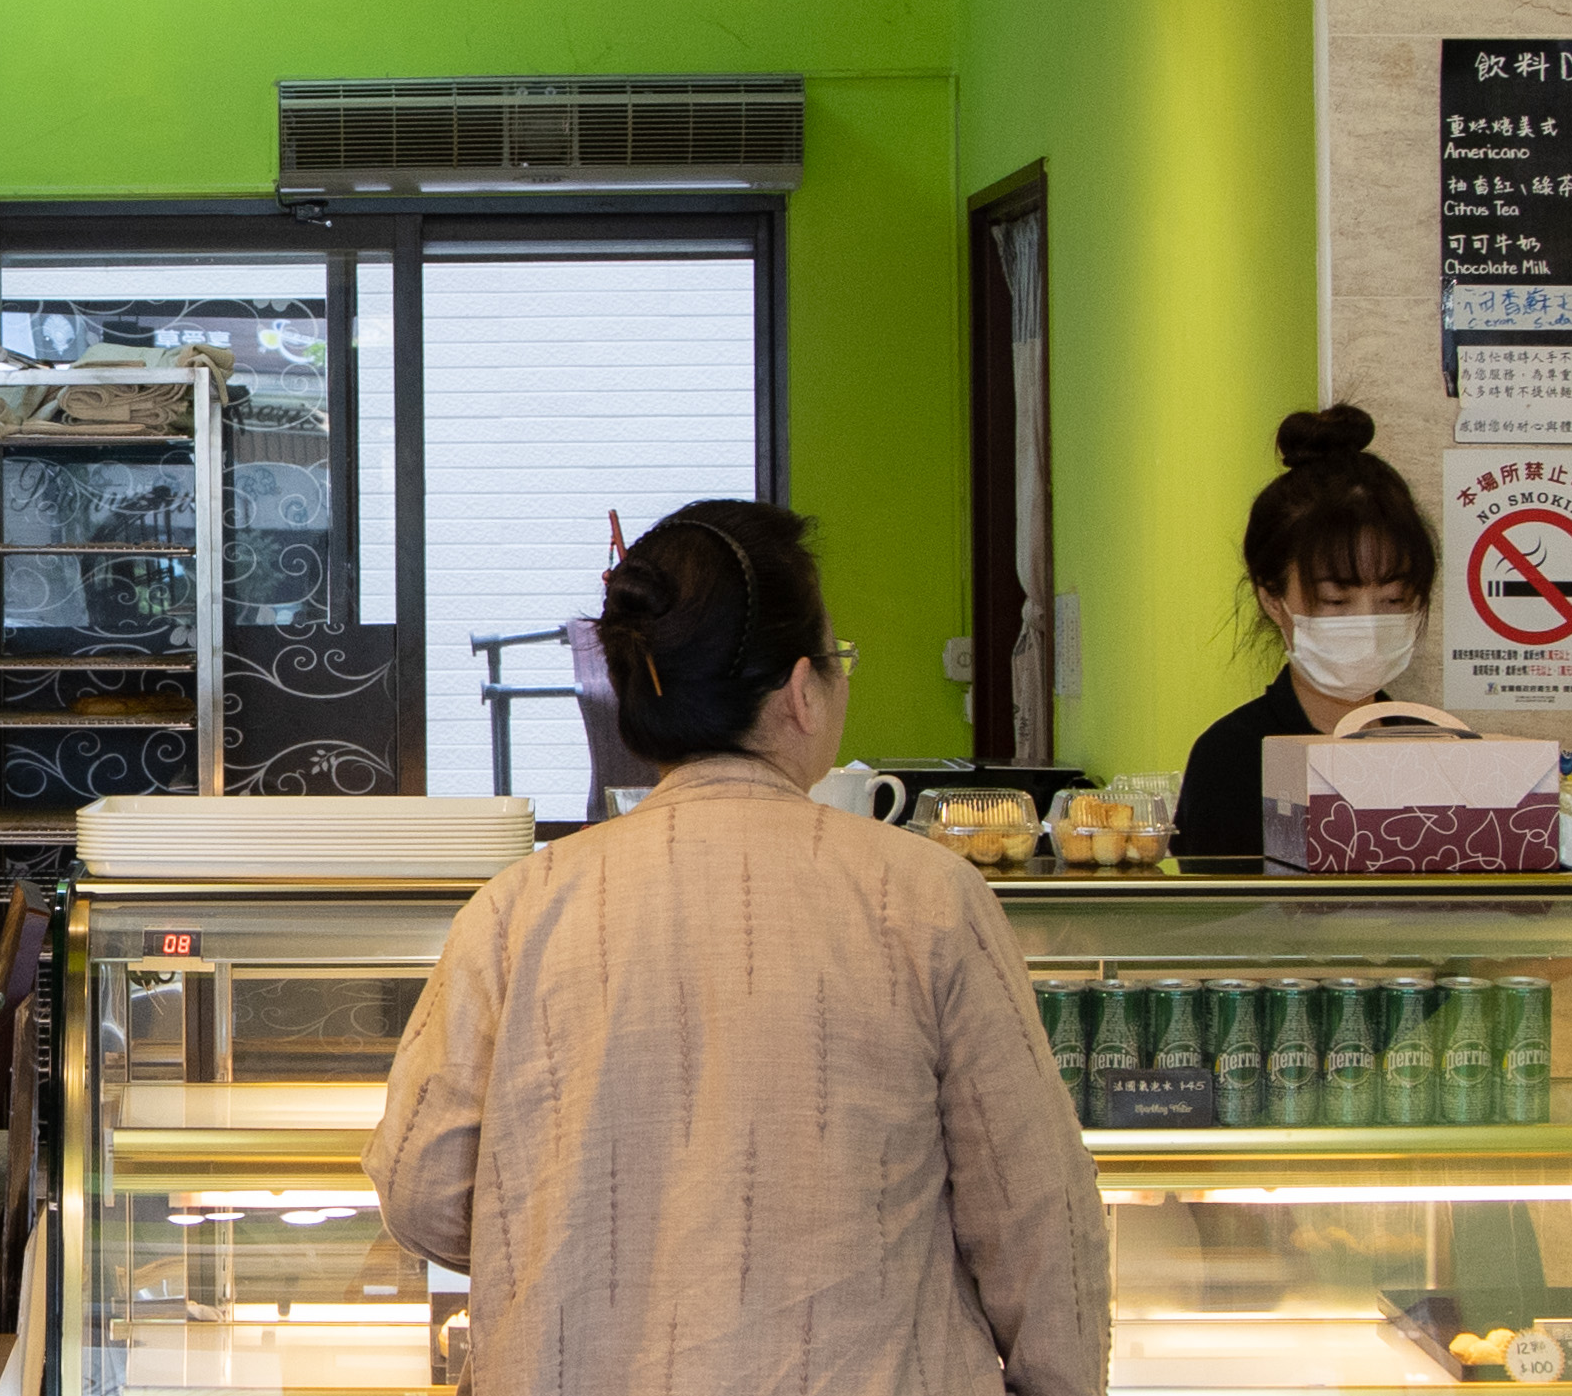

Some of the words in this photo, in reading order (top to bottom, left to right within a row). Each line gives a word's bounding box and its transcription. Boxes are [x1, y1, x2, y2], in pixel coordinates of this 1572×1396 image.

[1474, 51, 1551, 82] 飲料
[1445, 114, 1560, 139] 重烘焙美式
[1443, 141, 1531, 160] Americano
[1443, 200, 1490, 217] Citrus
[1494, 200, 1520, 217] Tea
[1447, 233, 1542, 255] 可可牛奶
[1444, 259, 1519, 275] Chocolate
[1521, 259, 1552, 276] Milk
[1476, 502, 1502, 525] NO
[162, 933, 192, 954] 08
[1520, 1360, 1554, 1374] $100
